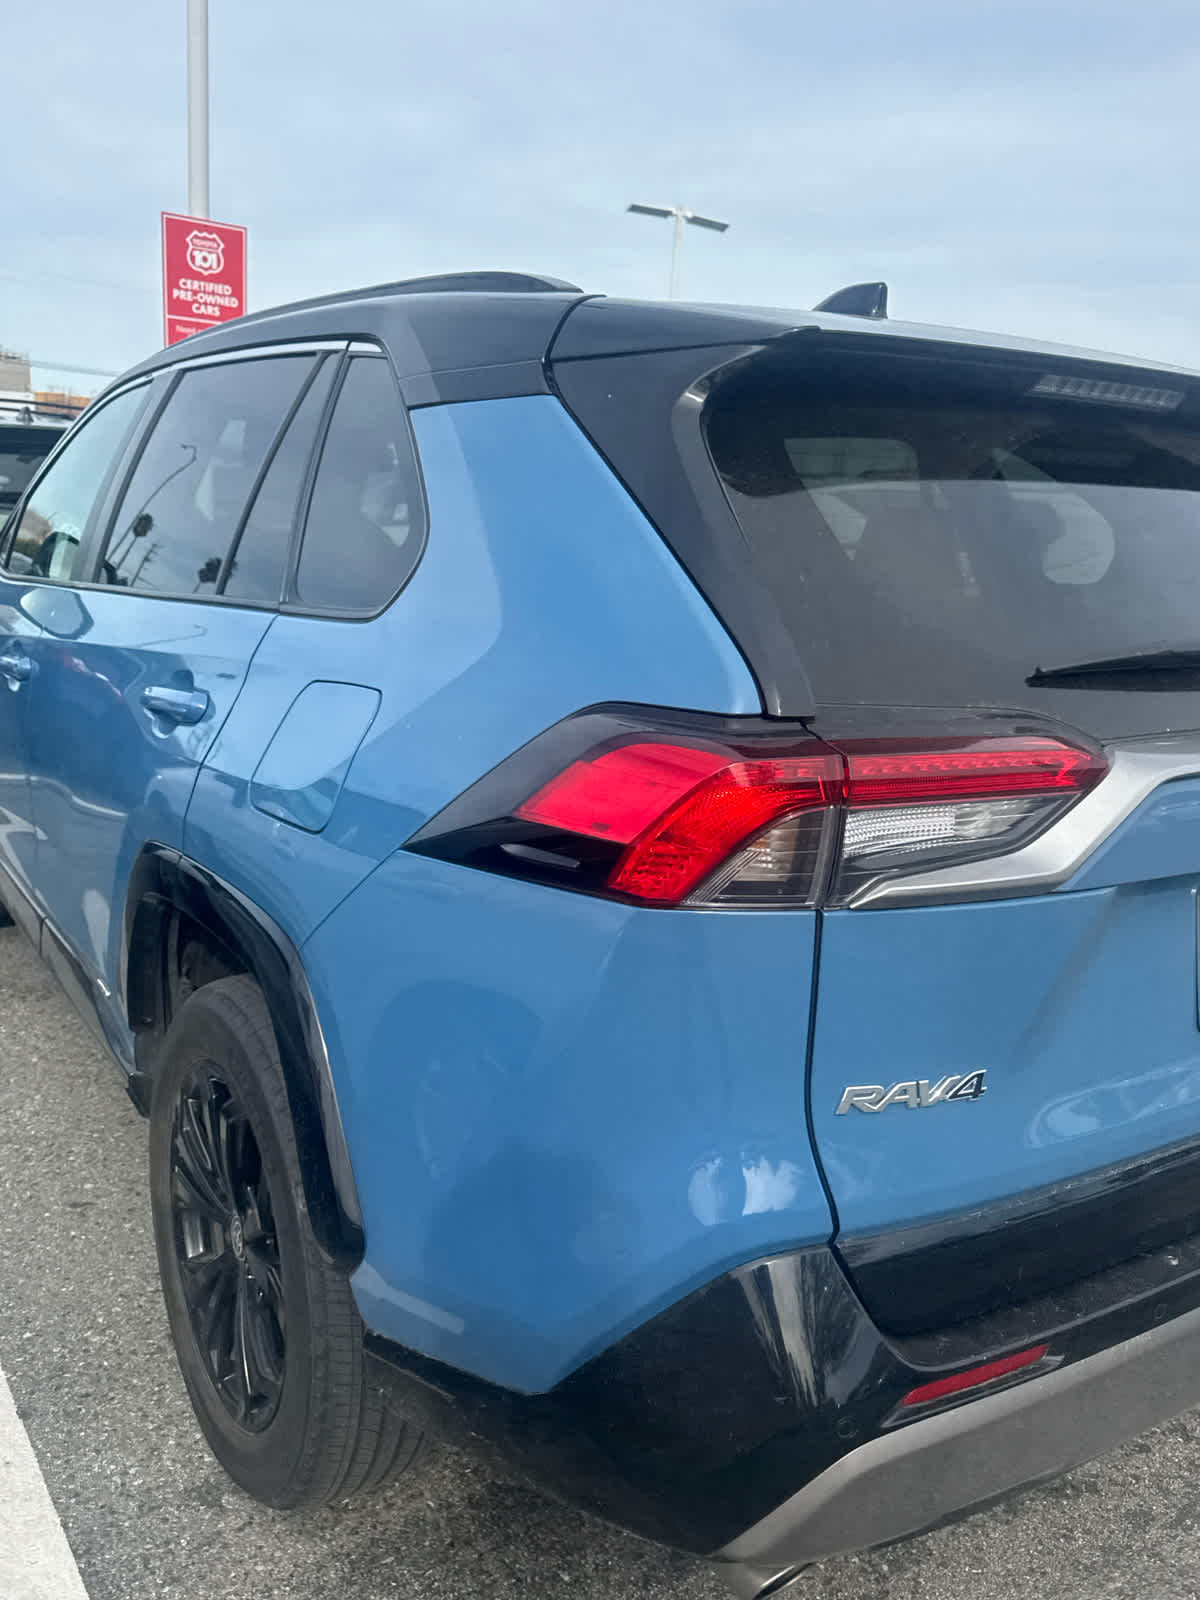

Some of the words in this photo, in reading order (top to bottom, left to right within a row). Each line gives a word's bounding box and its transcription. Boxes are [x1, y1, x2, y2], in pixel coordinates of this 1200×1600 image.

[192, 250, 218, 269] 101
[179, 278, 232, 295] CERTIFIED
[172, 288, 239, 308] PRE-OWNED
[192, 303, 220, 317] CARS
[836, 1069, 987, 1115] RAV4
